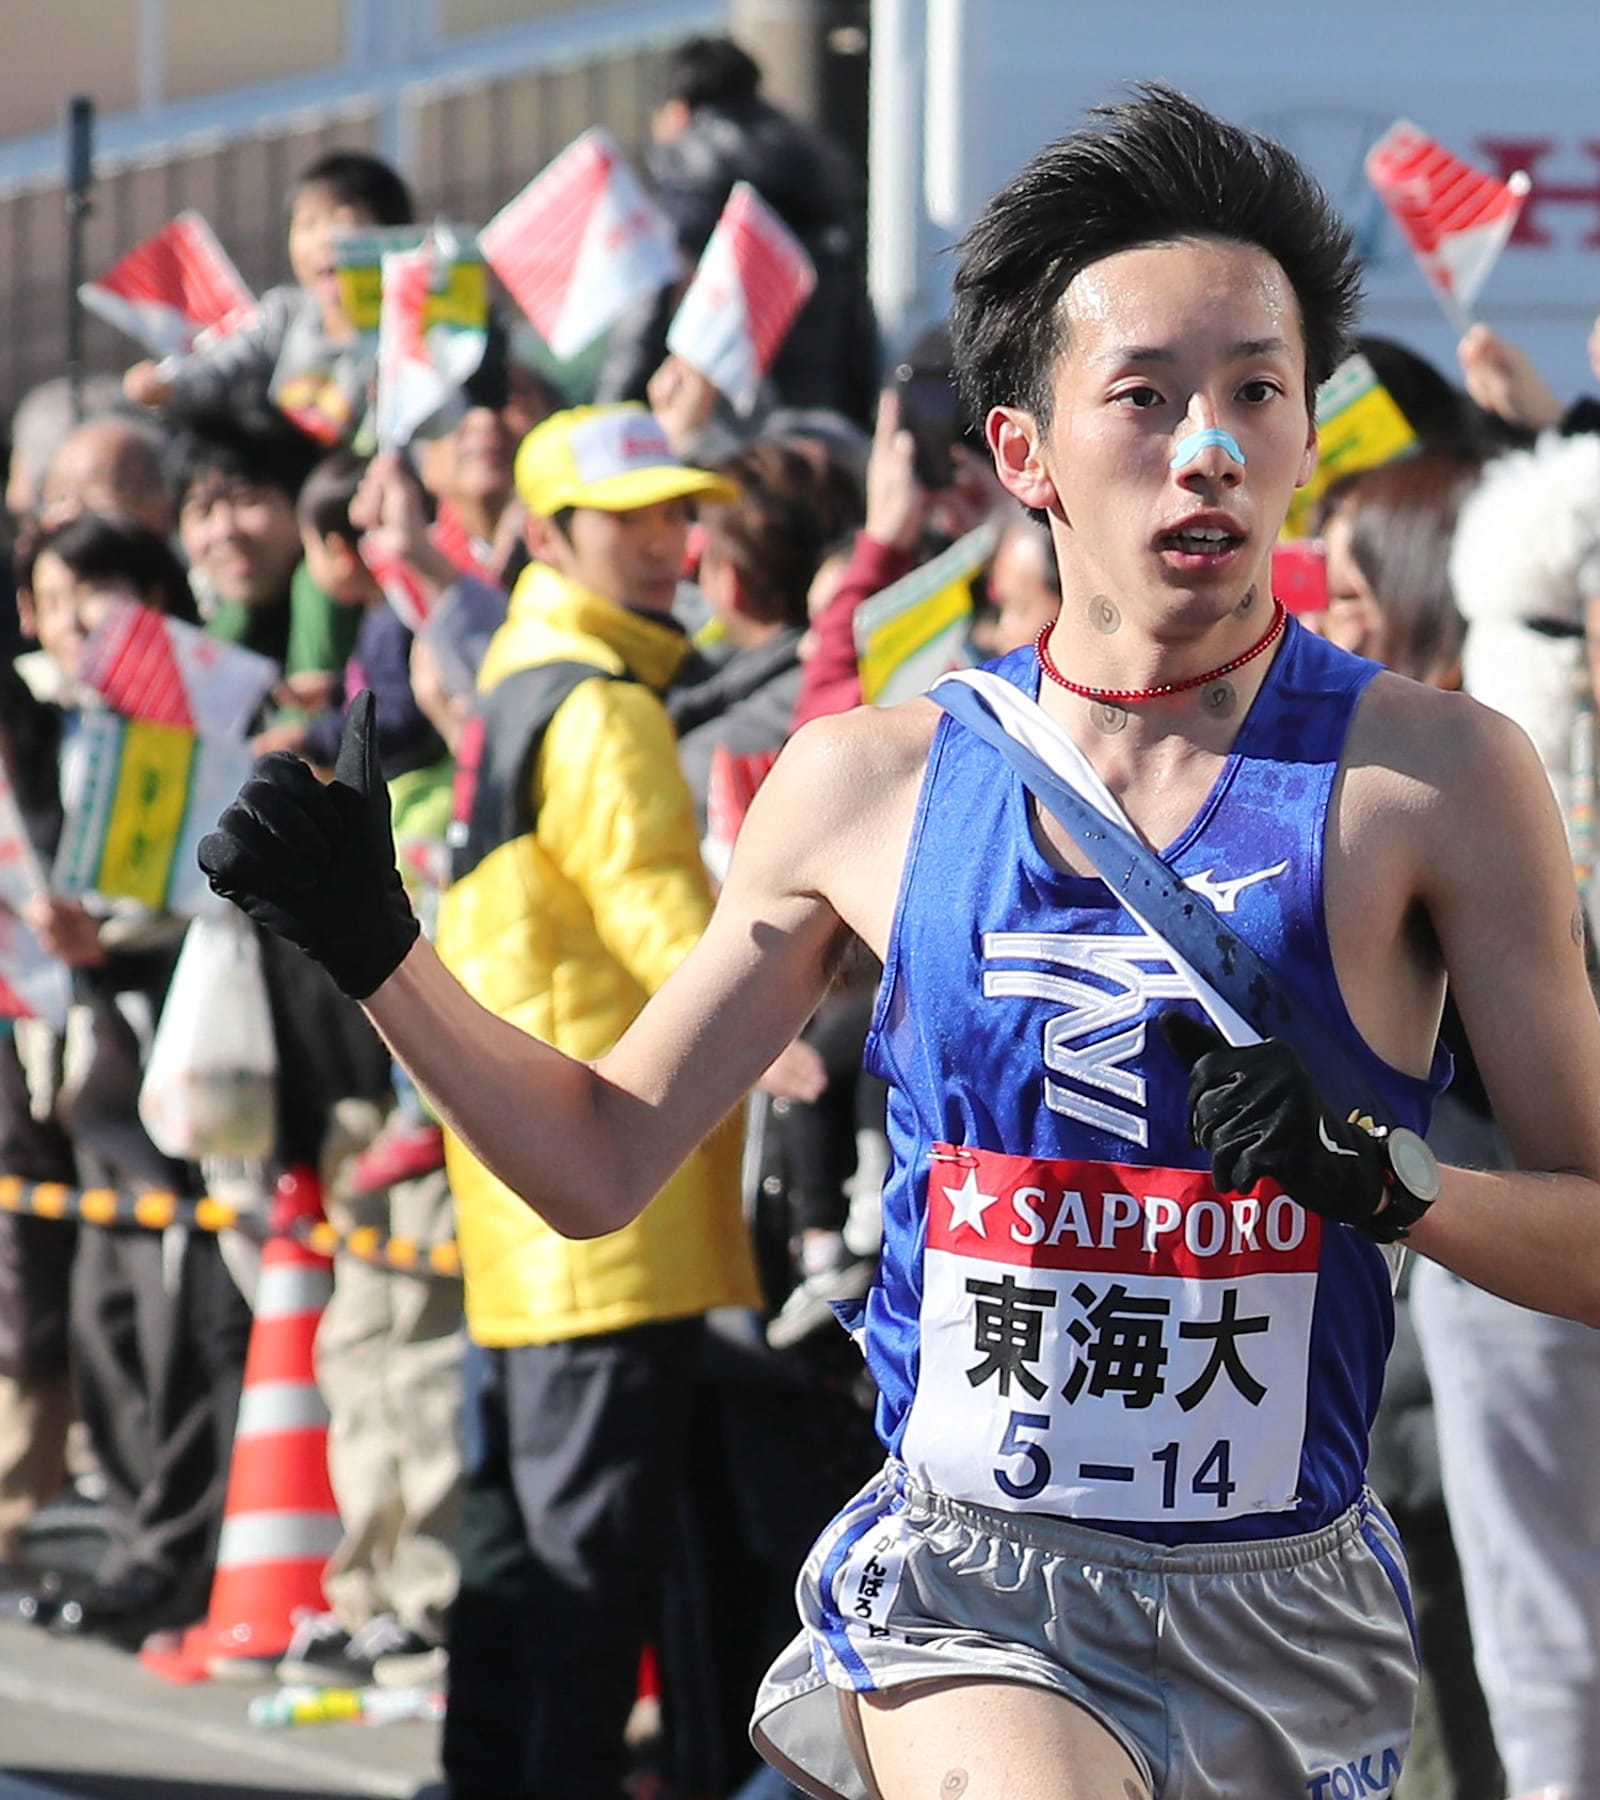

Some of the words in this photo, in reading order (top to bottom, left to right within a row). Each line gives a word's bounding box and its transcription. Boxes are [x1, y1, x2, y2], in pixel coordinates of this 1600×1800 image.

[1009, 1186, 1307, 1258] SAPPORO
[964, 1274, 1270, 1413] 東海大
